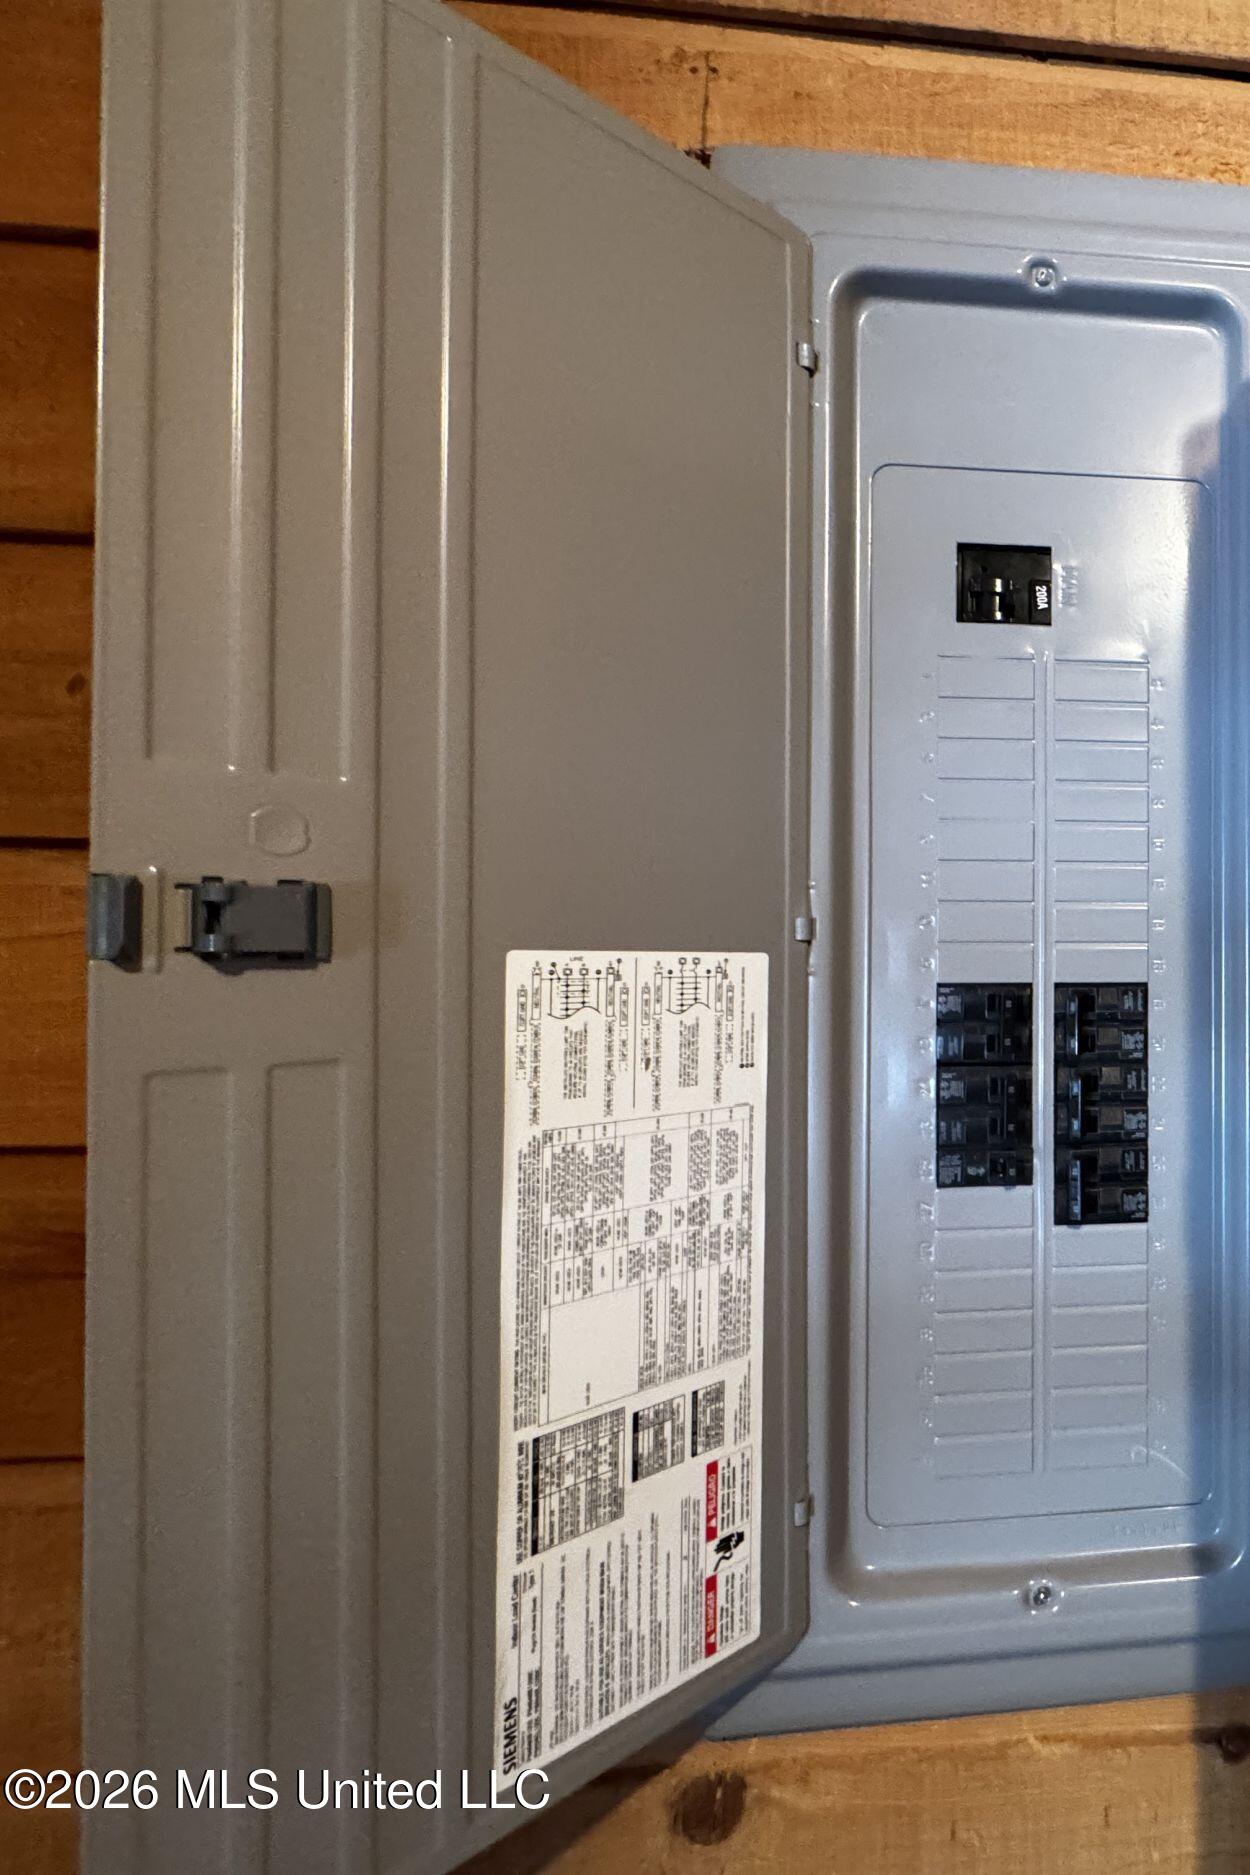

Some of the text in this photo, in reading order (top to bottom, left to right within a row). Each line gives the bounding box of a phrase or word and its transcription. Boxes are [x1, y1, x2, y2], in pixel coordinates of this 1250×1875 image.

[1035, 585, 1049, 610] 200A
[706, 1590, 715, 1632] DANGER
[503, 1697, 517, 1775] SIEMENS
